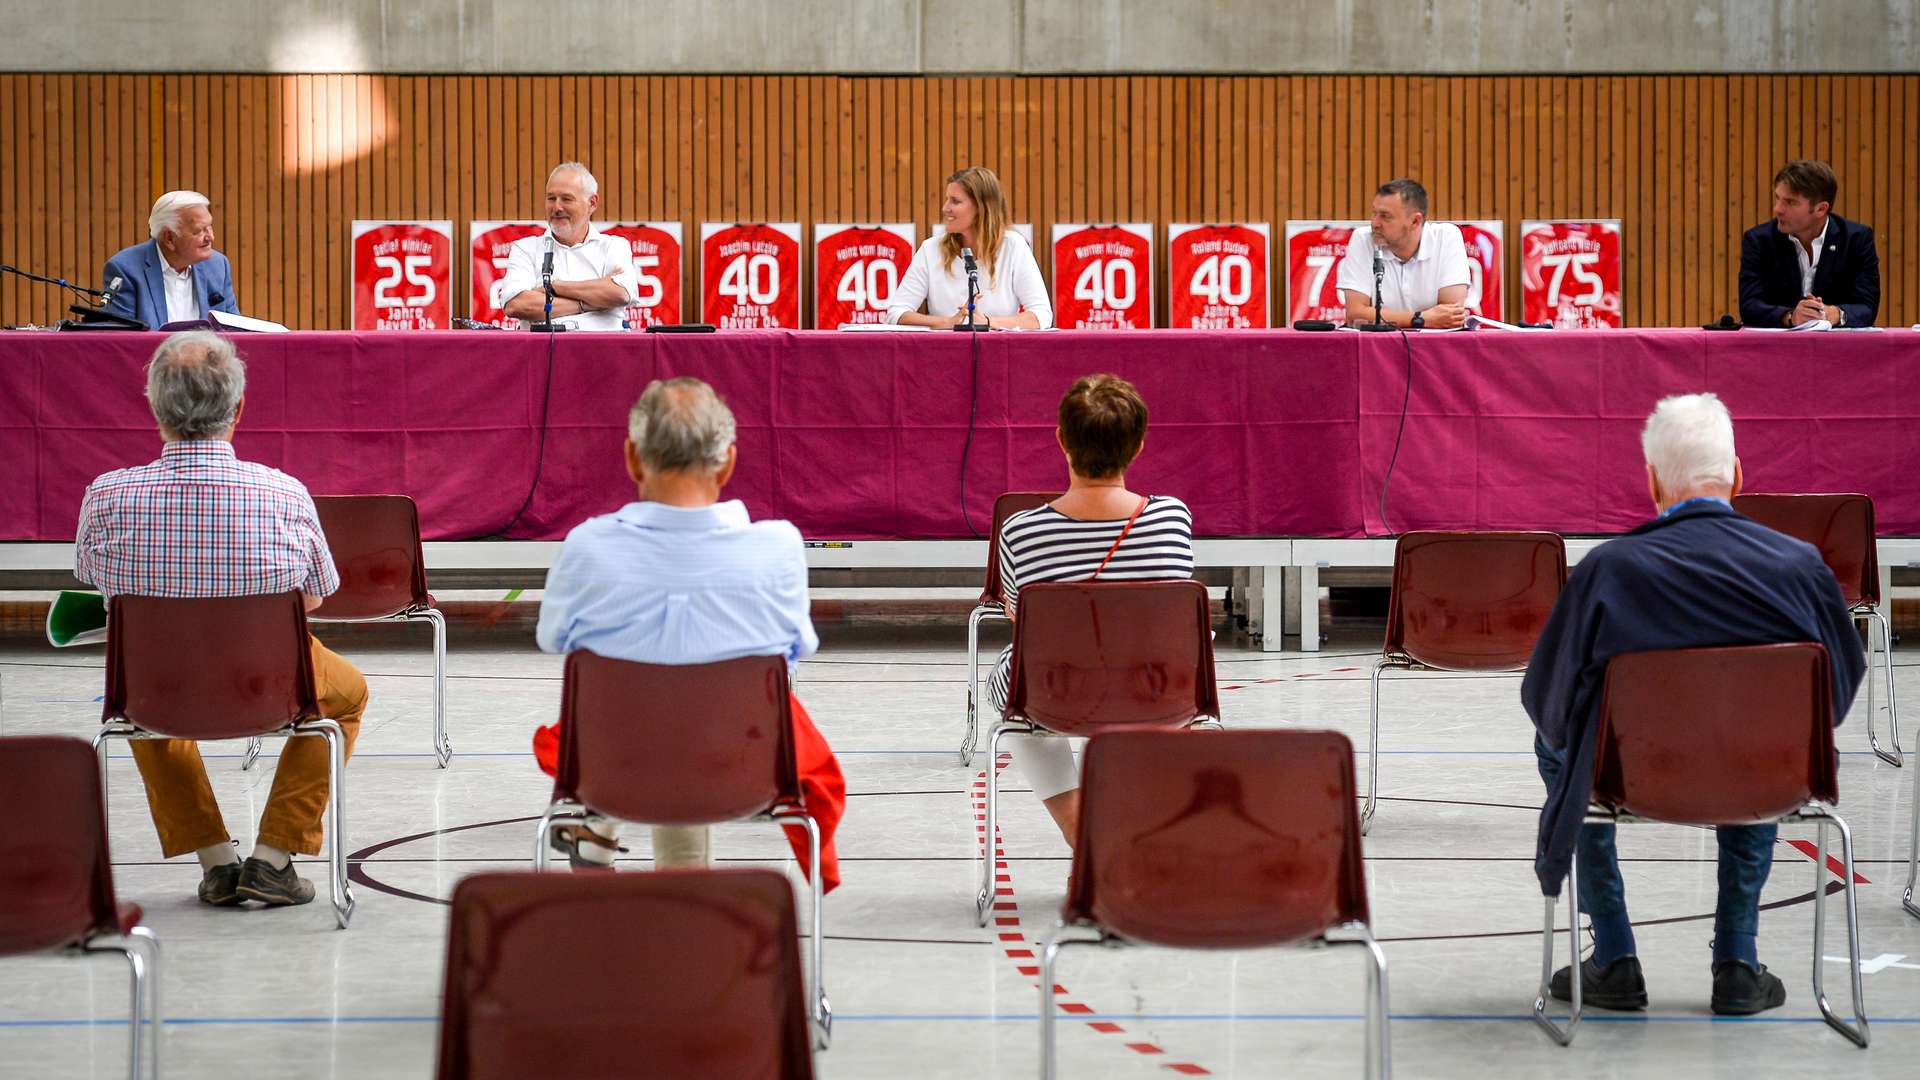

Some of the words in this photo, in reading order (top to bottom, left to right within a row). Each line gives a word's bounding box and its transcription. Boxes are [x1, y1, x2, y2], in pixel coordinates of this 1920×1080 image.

[374, 256, 436, 308] 25
[631, 256, 663, 307] 5
[718, 254, 780, 305] 40
[836, 259, 898, 311] 40
[1074, 258, 1136, 310] 40
[1190, 254, 1251, 306] 40
[1542, 252, 1604, 308] 75
[388, 307, 424, 320] Jahre
[720, 315, 757, 330] Bayer
[762, 315, 779, 330] 04
[732, 303, 768, 318] Jahre
[1088, 308, 1125, 322] Jahre
[1192, 316, 1228, 330] Bayer
[1202, 304, 1239, 318] Jahre
